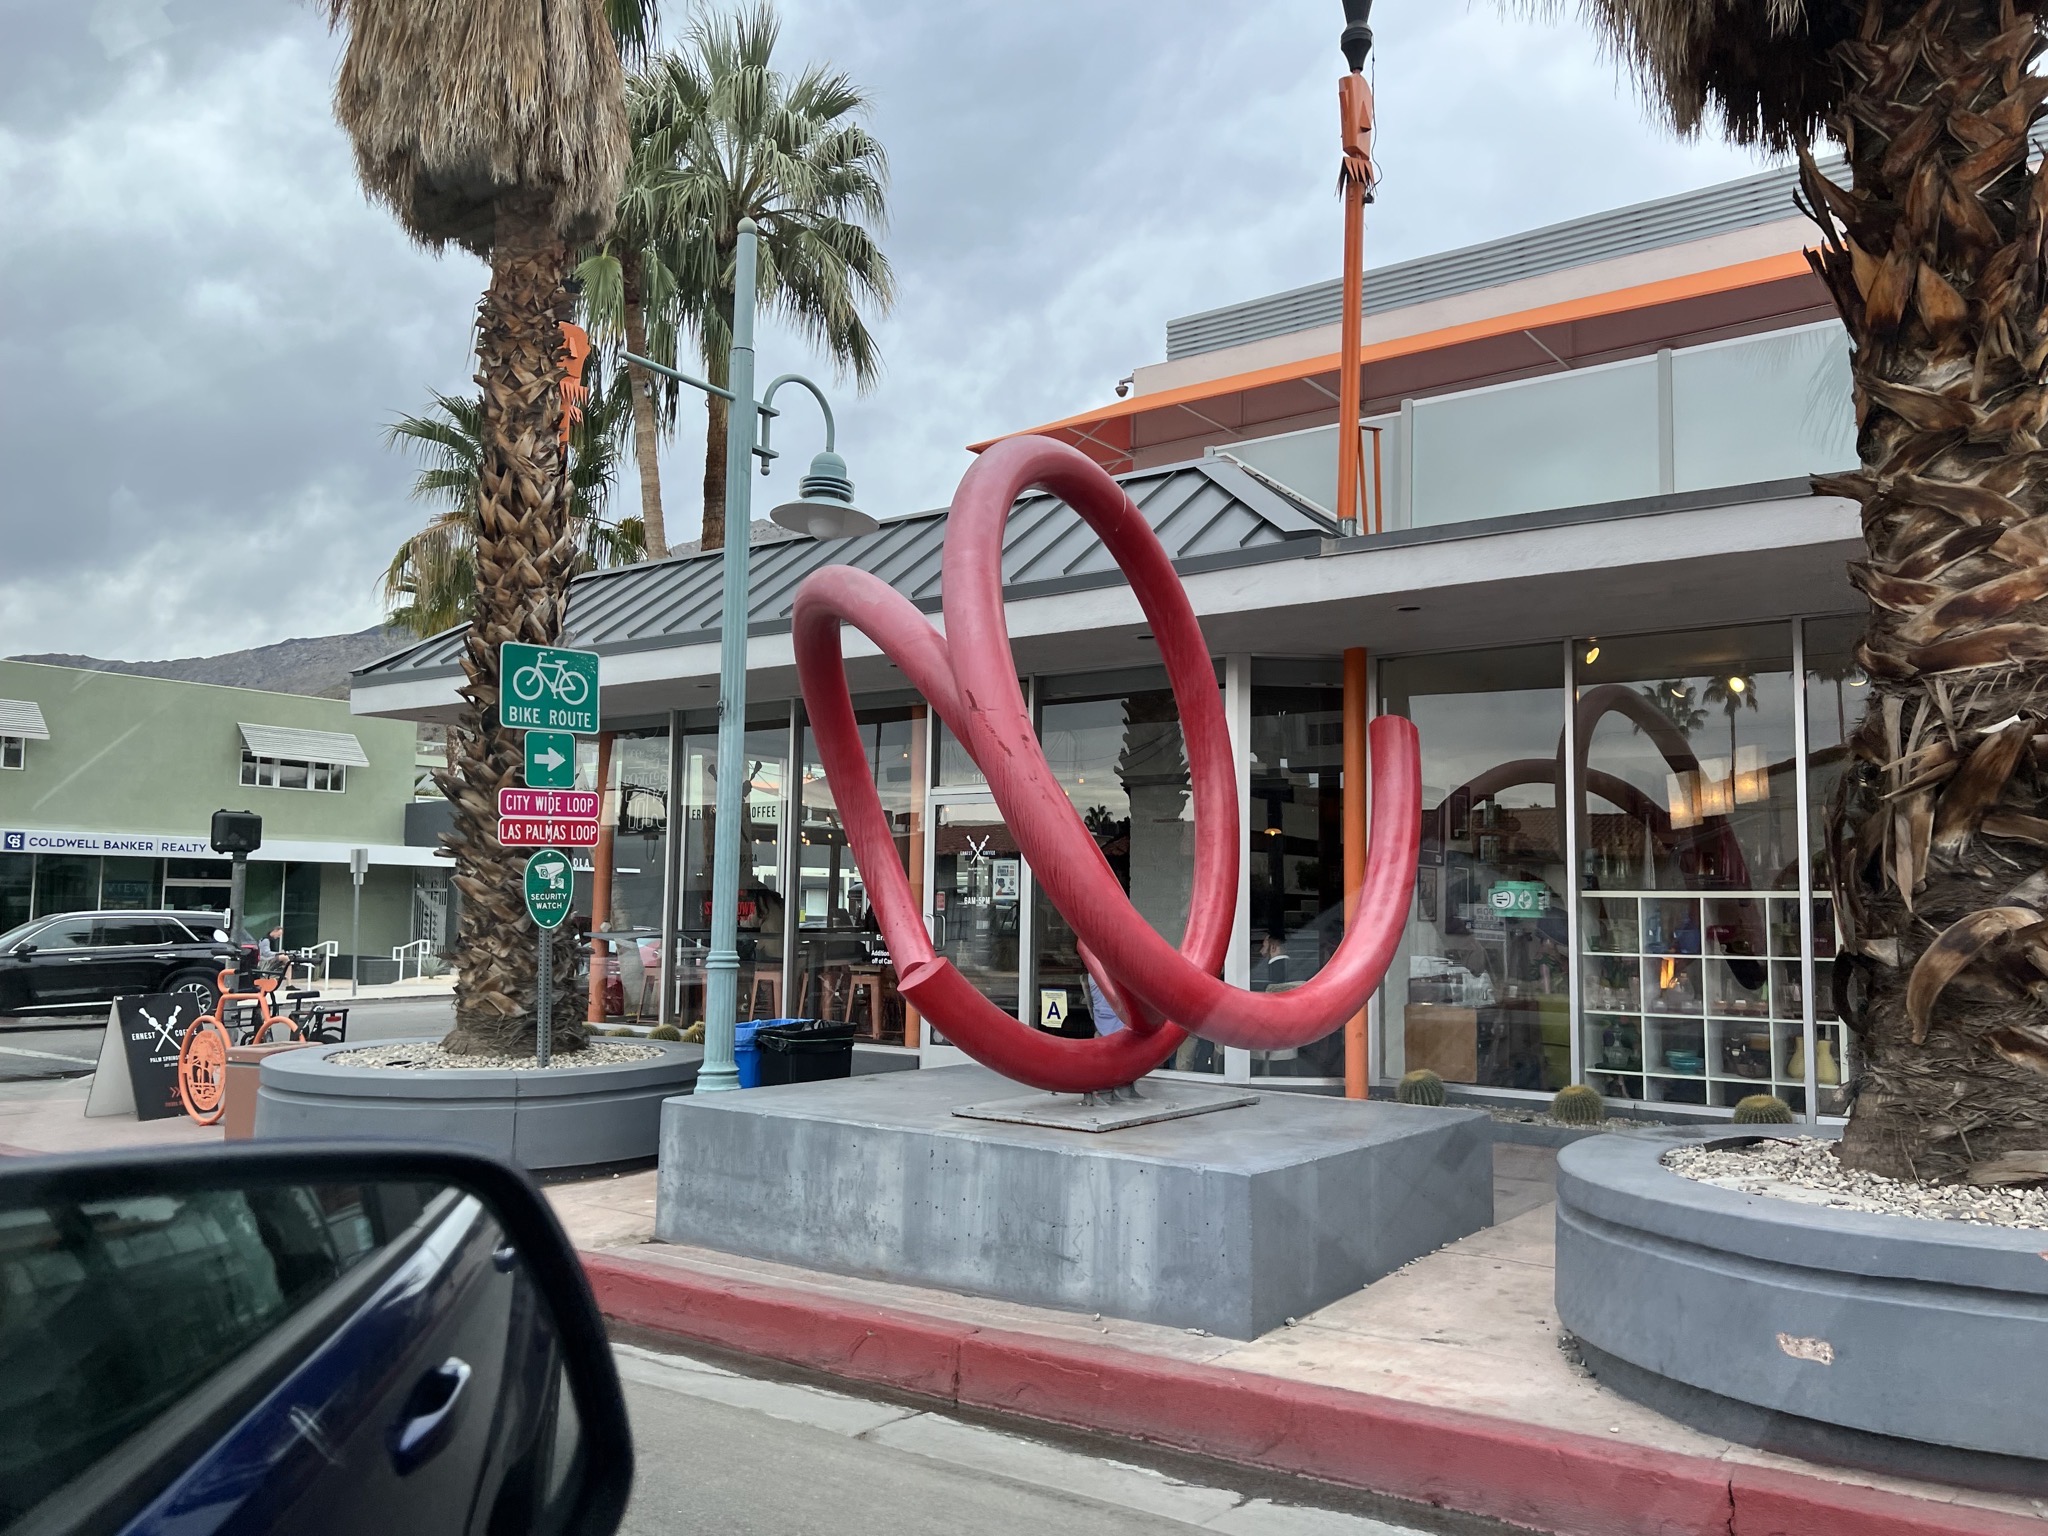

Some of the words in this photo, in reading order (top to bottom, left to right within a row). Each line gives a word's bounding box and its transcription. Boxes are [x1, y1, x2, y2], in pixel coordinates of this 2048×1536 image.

[509, 706, 541, 724] BIKE
[549, 709, 592, 728] ROUTE
[505, 794, 530, 811] CITY
[535, 795, 562, 813] WIDE
[566, 797, 594, 813] LOOP
[747, 806, 776, 818] OFFEE
[501, 823, 522, 840] LAS
[525, 824, 567, 841] PALMAS
[570, 825, 597, 841] LOOP
[29, 837, 100, 849] COLDWELL
[103, 840, 153, 851] BANKER
[161, 842, 207, 853] REALTY
[531, 893, 568, 901] SECURITY
[536, 902, 563, 910] WATCH
[1047, 1001, 1061, 1020] A
[131, 1031, 156, 1041] ERNEST
